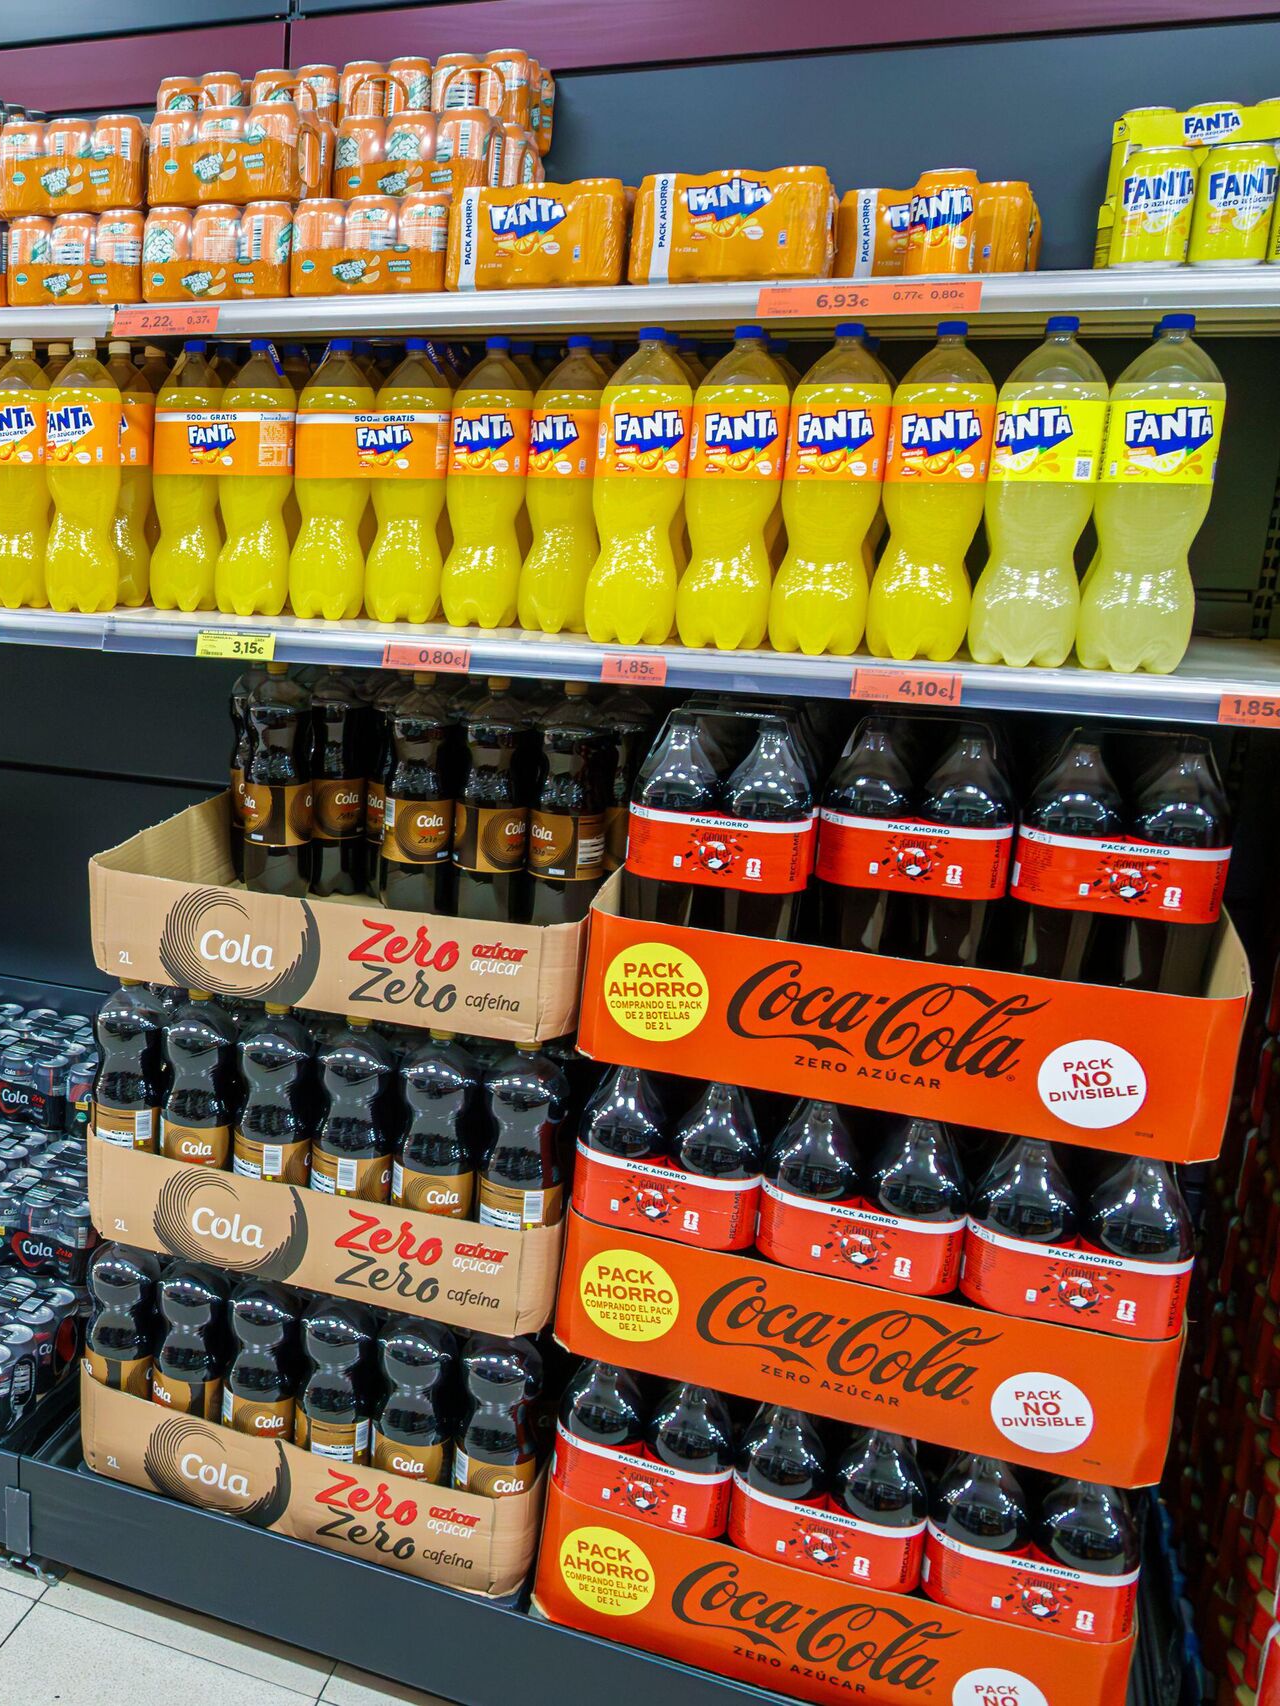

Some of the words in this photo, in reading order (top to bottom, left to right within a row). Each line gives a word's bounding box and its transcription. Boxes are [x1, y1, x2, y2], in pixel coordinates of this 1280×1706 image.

[1184, 112, 1240, 134] FANTA
[688, 178, 770, 213] FANTA
[1124, 170, 1194, 205] FANTA
[660, 179, 669, 221] AHORRO
[911, 188, 973, 224] FANTA
[490, 197, 567, 231] FANTA
[658, 223, 666, 248] PACK
[464, 239, 472, 265] PACK
[816, 294, 869, 310] 6,93€
[383, 414, 415, 422] GRATIS
[614, 411, 684, 441] FANTA
[705, 411, 778, 442] FANTA
[798, 411, 874, 446] FANTA
[901, 411, 982, 446] FANTA
[998, 407, 1072, 442] FANTA
[1125, 407, 1212, 442] FANTA
[0, 429, 28, 437] azúcares
[188, 424, 235, 446] FANTA
[357, 425, 413, 448] FANTA
[453, 414, 514, 444] FANTA
[233, 641, 264, 654] 3,15€
[419, 650, 461, 665] 0,80€
[616, 660, 655, 675] 1,85€
[899, 680, 948, 698] 4,10€
[1234, 699, 1280, 717] 1,85€
[417, 813, 444, 828] Cola
[690, 817, 712, 825] PACK
[714, 819, 749, 829] AHORRO
[1101, 843, 1128, 852] PACK
[1129, 845, 1170, 856] AHORRO
[199, 929, 274, 971] Cola
[348, 919, 461, 972] Zero
[471, 941, 528, 962] azúcar
[119, 950, 133, 965] 2L
[471, 957, 523, 977] açúcar
[624, 963, 684, 979] PACK
[348, 962, 457, 1013] Zero
[608, 982, 703, 998] AHORRO
[465, 992, 521, 1013] cafeína
[610, 1000, 665, 1010] COMPRANDO
[666, 1001, 677, 1010] EL
[679, 1001, 703, 1010] PACK
[625, 1011, 637, 1020] DE
[638, 1012, 645, 1020] 2
[646, 1011, 690, 1021] BOTELLAS
[645, 1021, 658, 1030] DE
[659, 1022, 665, 1030] 2
[666, 1022, 673, 1030] L
[727, 959, 1052, 1080] Coca-Cola
[794, 1054, 848, 1074] ZERO
[857, 1064, 942, 1090] AZÚCAR
[1063, 1058, 1115, 1073] PACK
[1072, 1071, 1113, 1089] NO
[1049, 1085, 1139, 1102] DIVISIBLE
[181, 1141, 212, 1156] Cola
[114, 1219, 129, 1233] 2L
[830, 1206, 856, 1217] PACK
[858, 1212, 899, 1226] AHORRO
[191, 1207, 265, 1249] Cola
[335, 1209, 443, 1267] Zero
[23, 1240, 54, 1258] Cola
[454, 1243, 509, 1264] azúcar
[452, 1255, 504, 1276] açúcar
[597, 1265, 655, 1285] PACK
[335, 1249, 440, 1304] Zero
[447, 1289, 500, 1310] cafeína
[583, 1281, 673, 1305] AHORRO
[585, 1299, 637, 1313] COMPRANDO
[638, 1304, 649, 1314] EL
[650, 1305, 673, 1316] PACK
[698, 1275, 1004, 1402] Coca-Cola
[761, 1363, 810, 1382] ZERO
[821, 1378, 901, 1407] AZÚCAR
[1015, 1391, 1063, 1402] PACK
[1023, 1402, 1061, 1418] NO
[1001, 1417, 1087, 1428] DIVISIBLE
[107, 1455, 121, 1470] 2L
[179, 1453, 251, 1498] Cola
[316, 1468, 418, 1527] Zero
[429, 1505, 481, 1528] azúcar
[316, 1505, 416, 1561] Zero
[426, 1517, 477, 1540] açúcar
[422, 1547, 474, 1570] cafeína
[577, 1540, 632, 1563] PACK
[563, 1554, 650, 1583] AHORRO
[672, 1560, 962, 1691] Coca-Cola
[733, 1644, 782, 1665] ZERO
[790, 1663, 867, 1695] AZÚCAR
[974, 1685, 1021, 1696] PACK
[982, 1696, 1019, 1706] NO
